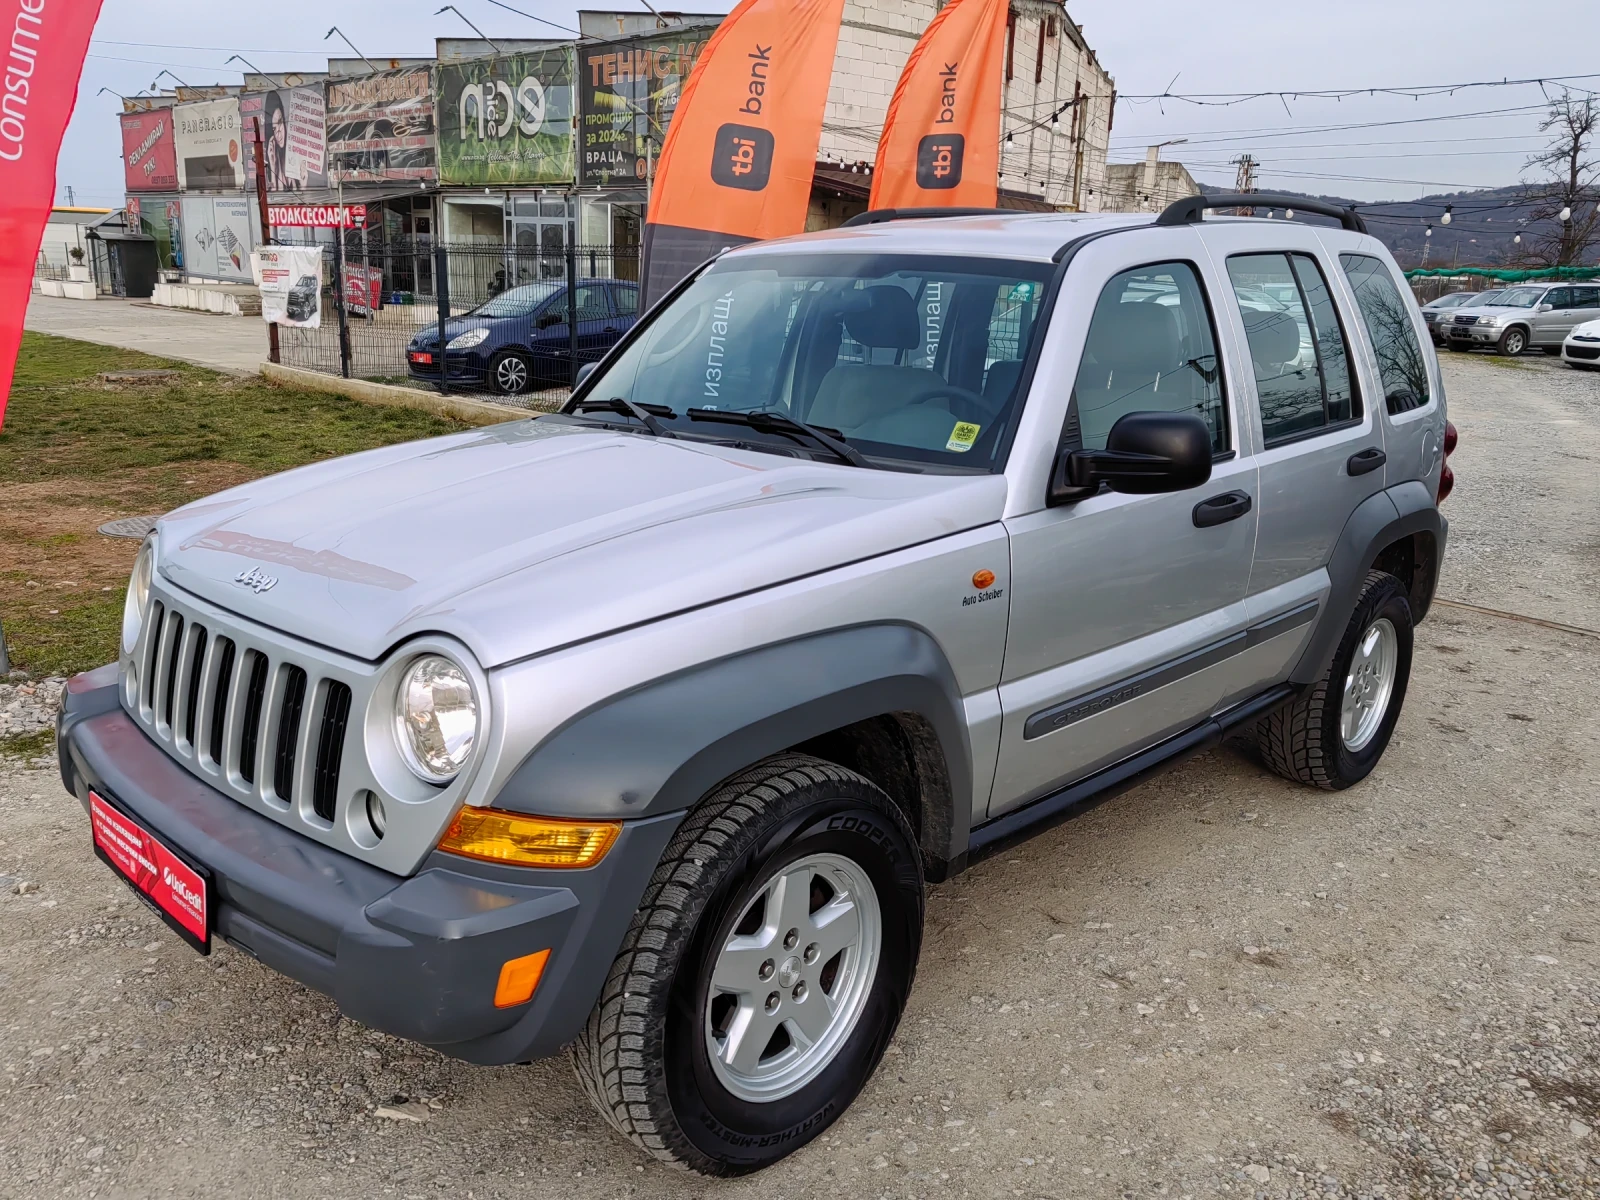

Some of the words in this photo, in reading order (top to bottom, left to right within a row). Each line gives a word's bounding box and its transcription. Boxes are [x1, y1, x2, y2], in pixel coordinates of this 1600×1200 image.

[588, 45, 671, 87] ТЕНИС
[739, 43, 772, 116] bank
[935, 61, 958, 124] bank
[585, 112, 633, 126] ПРОМОЦИЯ
[128, 118, 165, 167] РЕКЛАМИРАЙ
[586, 133, 597, 147] за
[586, 151, 627, 164] ВРАЦА,
[731, 138, 756, 176] tbi
[143, 156, 156, 177] ТУК!
[932, 145, 952, 179] tbi
[268, 207, 350, 226] ВТОАКСЕСОАРИ
[704, 290, 735, 397] изплащ
[234, 566, 278, 594] Jeep
[962, 594, 976, 607] Auto
[978, 588, 1003, 603] Scheiber
[1052, 684, 1142, 727] CHEROKEE
[171, 874, 203, 913] UniCredit
